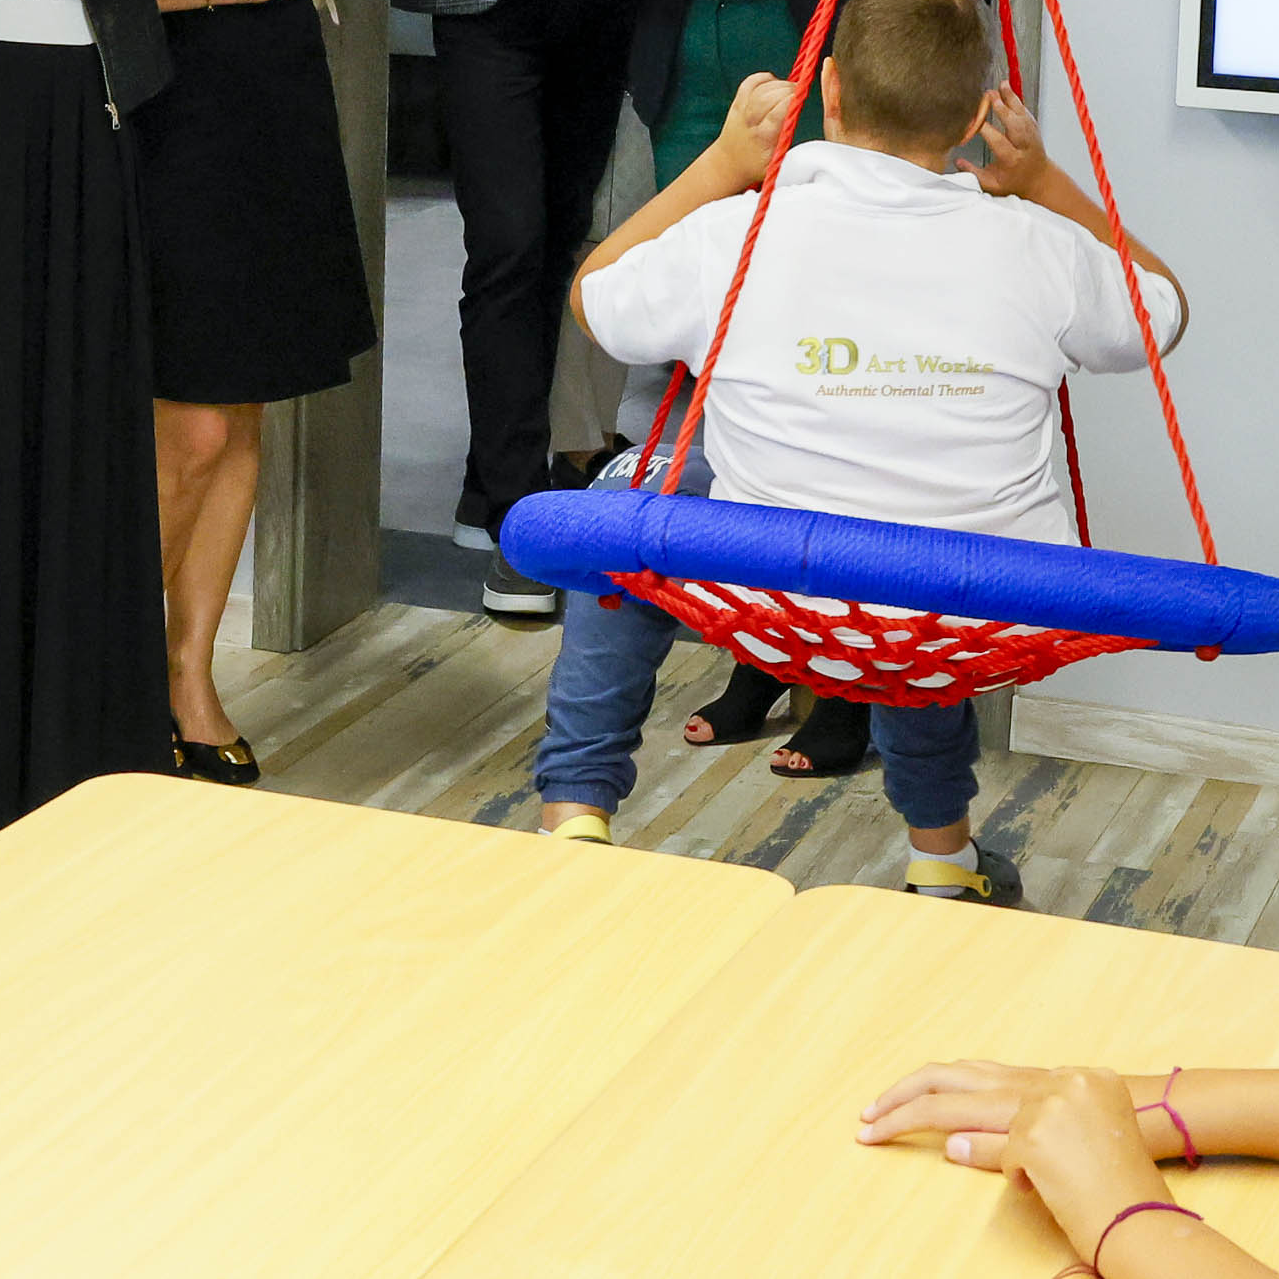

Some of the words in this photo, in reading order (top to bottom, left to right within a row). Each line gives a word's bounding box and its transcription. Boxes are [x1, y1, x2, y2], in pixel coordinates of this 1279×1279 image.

[795, 337, 859, 375] 3D
[865, 353, 906, 373] Art
[912, 354, 994, 374] Works
[815, 383, 877, 397] Authentic
[880, 383, 934, 397] Oriental
[938, 383, 985, 396] Themes
